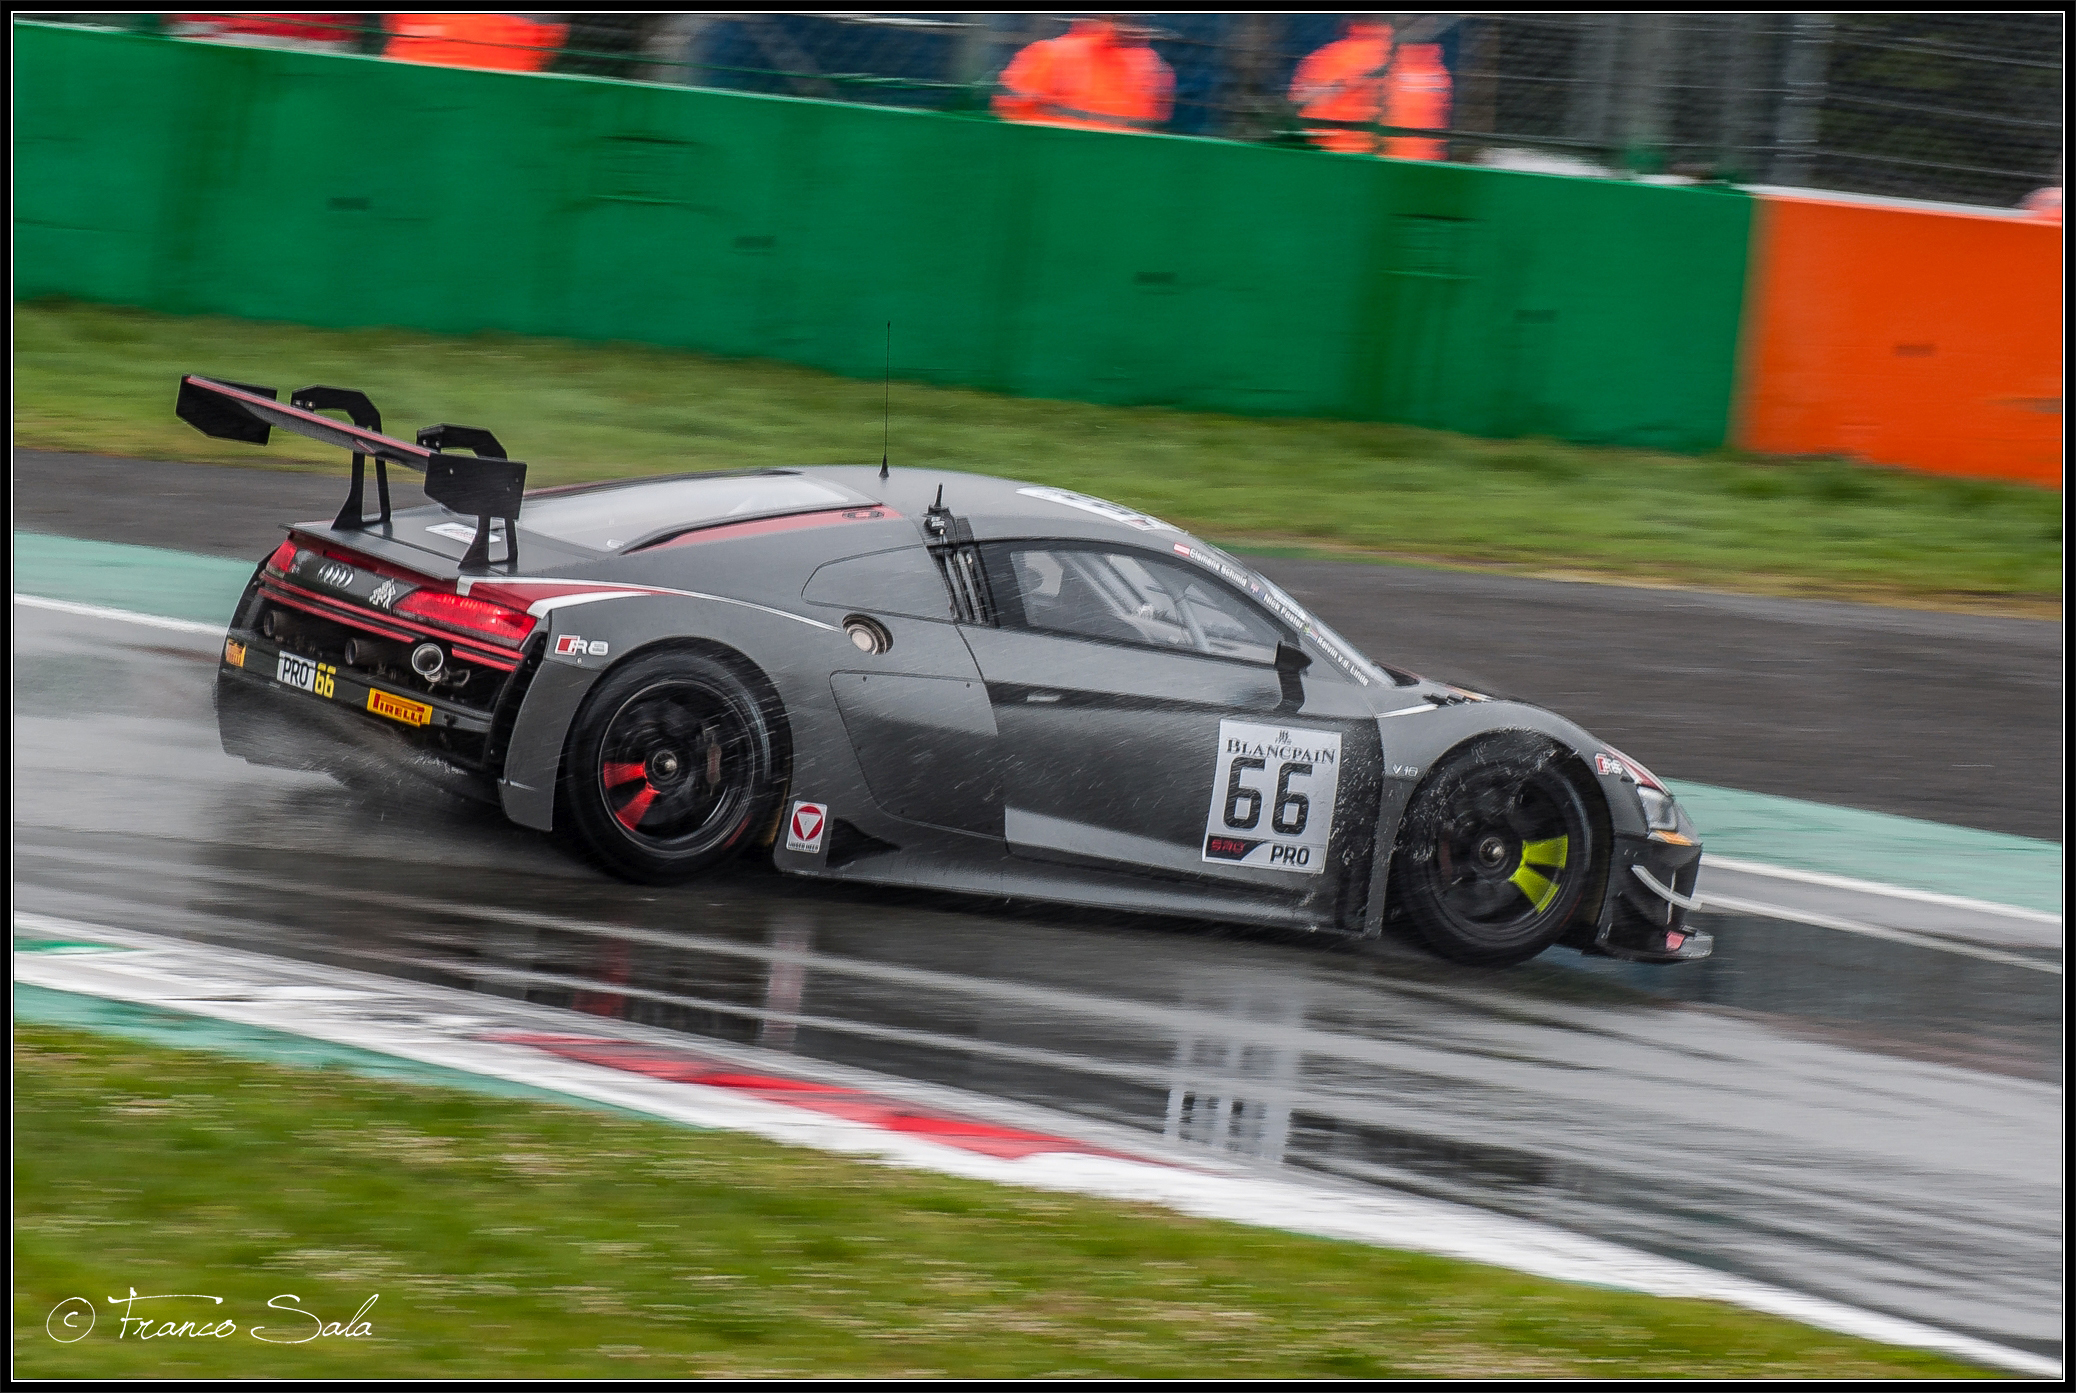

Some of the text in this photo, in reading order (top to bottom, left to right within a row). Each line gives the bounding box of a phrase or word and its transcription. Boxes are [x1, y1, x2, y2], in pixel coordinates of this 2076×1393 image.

[282, 657, 336, 698] PRO 66
[372, 692, 425, 724] PIRELLI
[1226, 738, 1336, 765] BLANCPAIN
[1222, 756, 1314, 835] 66
[1270, 844, 1310, 867] PRO
